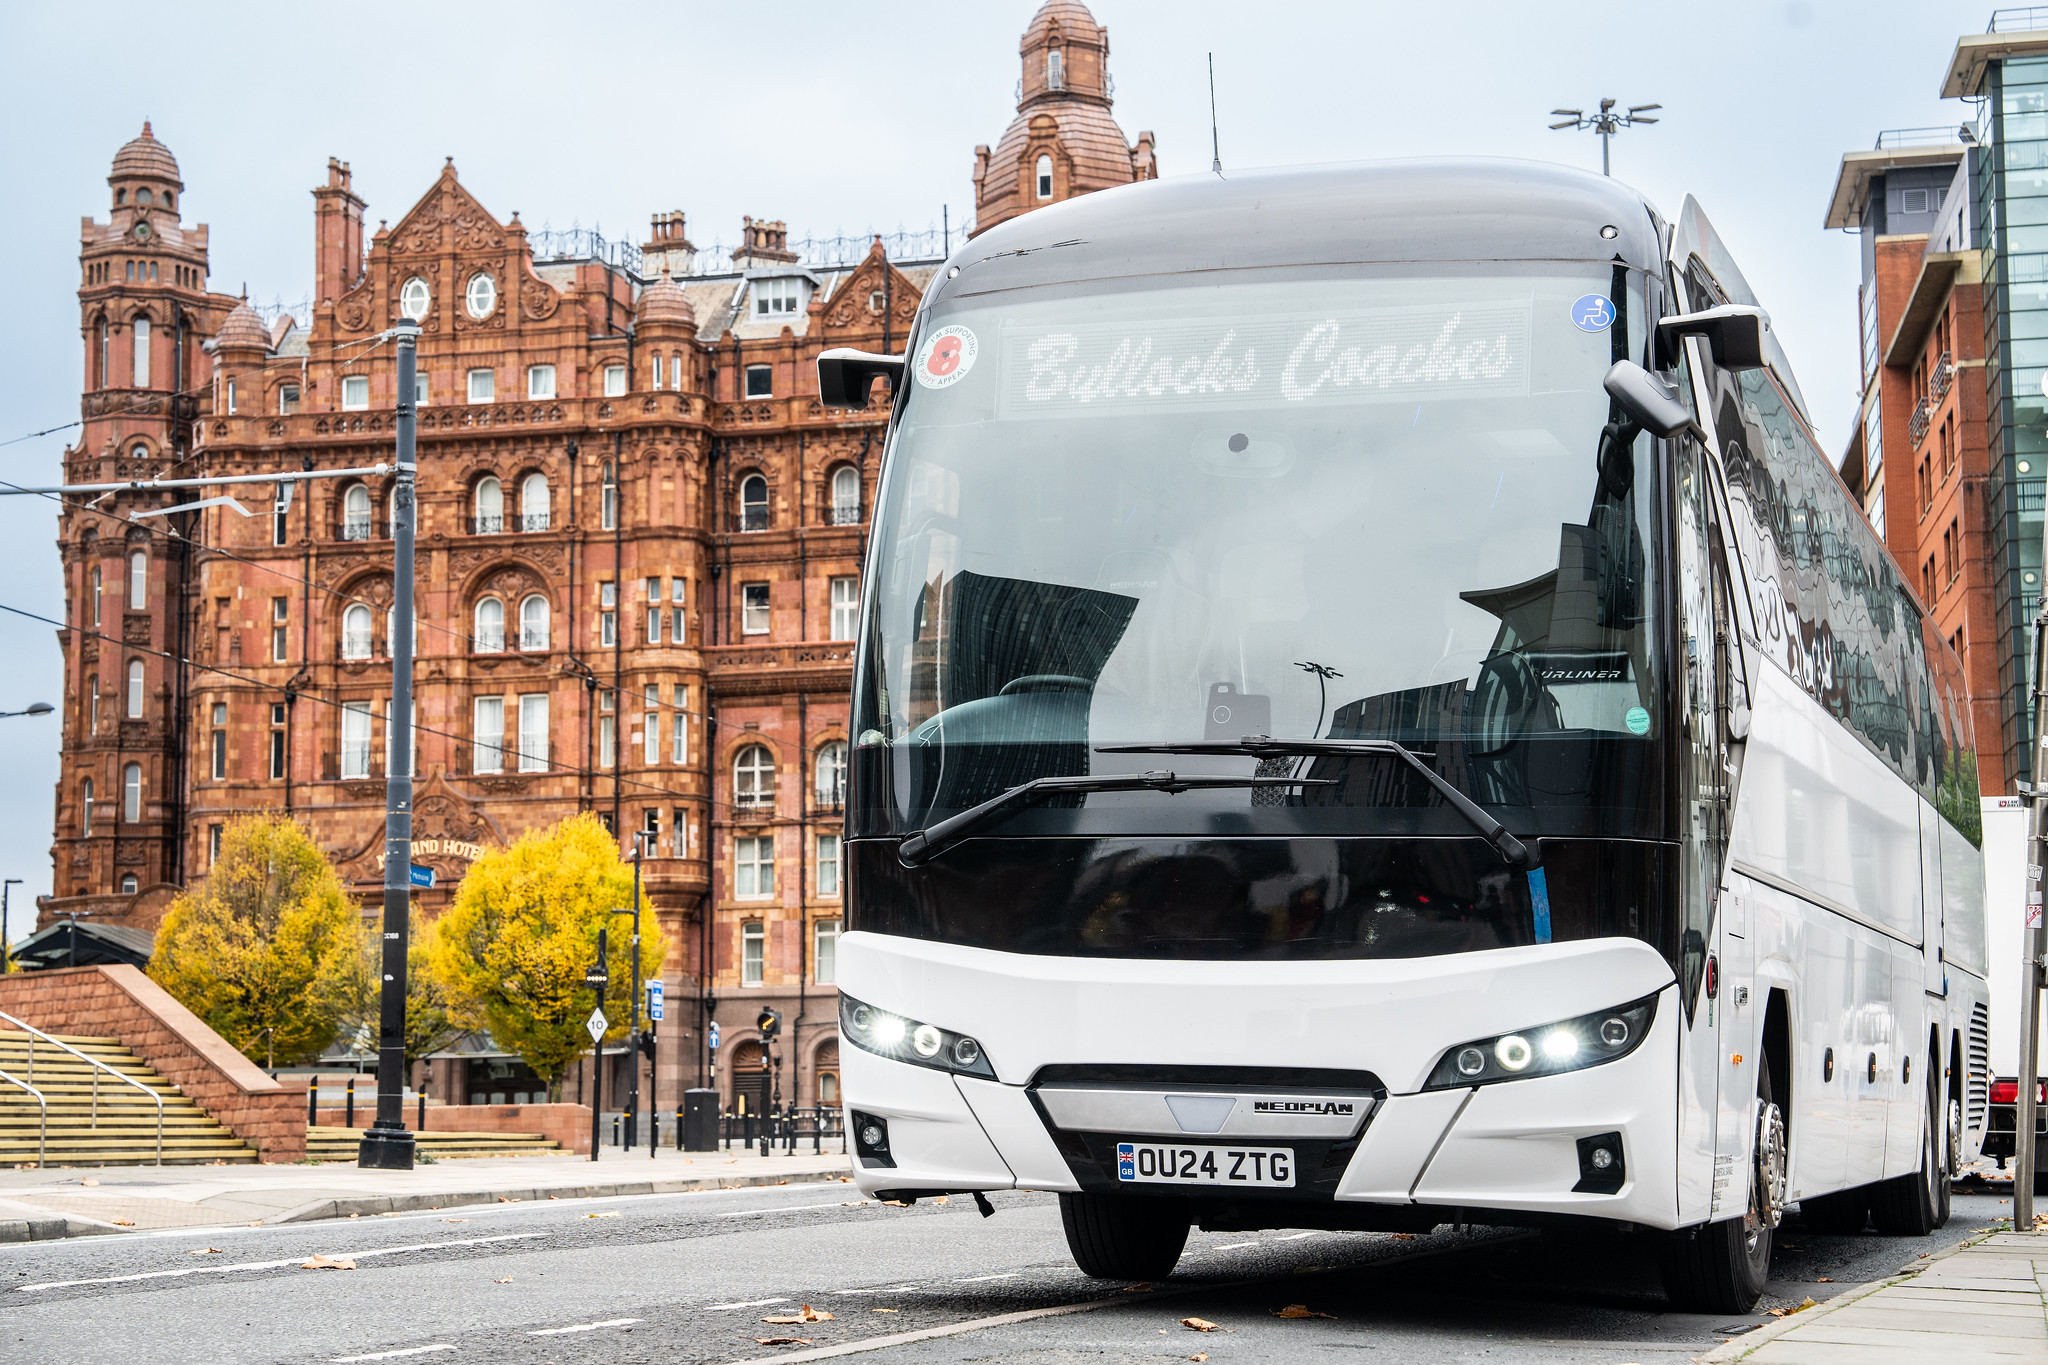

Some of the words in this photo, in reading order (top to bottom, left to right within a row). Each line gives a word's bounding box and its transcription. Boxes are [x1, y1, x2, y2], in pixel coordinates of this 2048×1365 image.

[930, 332, 943, 343] I'M
[945, 327, 976, 356] SUPPORTING
[919, 353, 927, 367] THE
[1026, 329, 1261, 402] Bullocks
[1281, 311, 1513, 401] Coaches
[920, 368, 935, 385] POPPY
[937, 367, 966, 386] APPEAL
[1540, 670, 1621, 679] URLINER
[376, 839, 439, 870] MAND
[591, 1020, 604, 1030] 10
[1254, 1101, 1354, 1115] NEOPLAN
[1121, 1167, 1133, 1177] GB
[1137, 1148, 1218, 1180] OU24
[1227, 1151, 1290, 1182] ZTG
